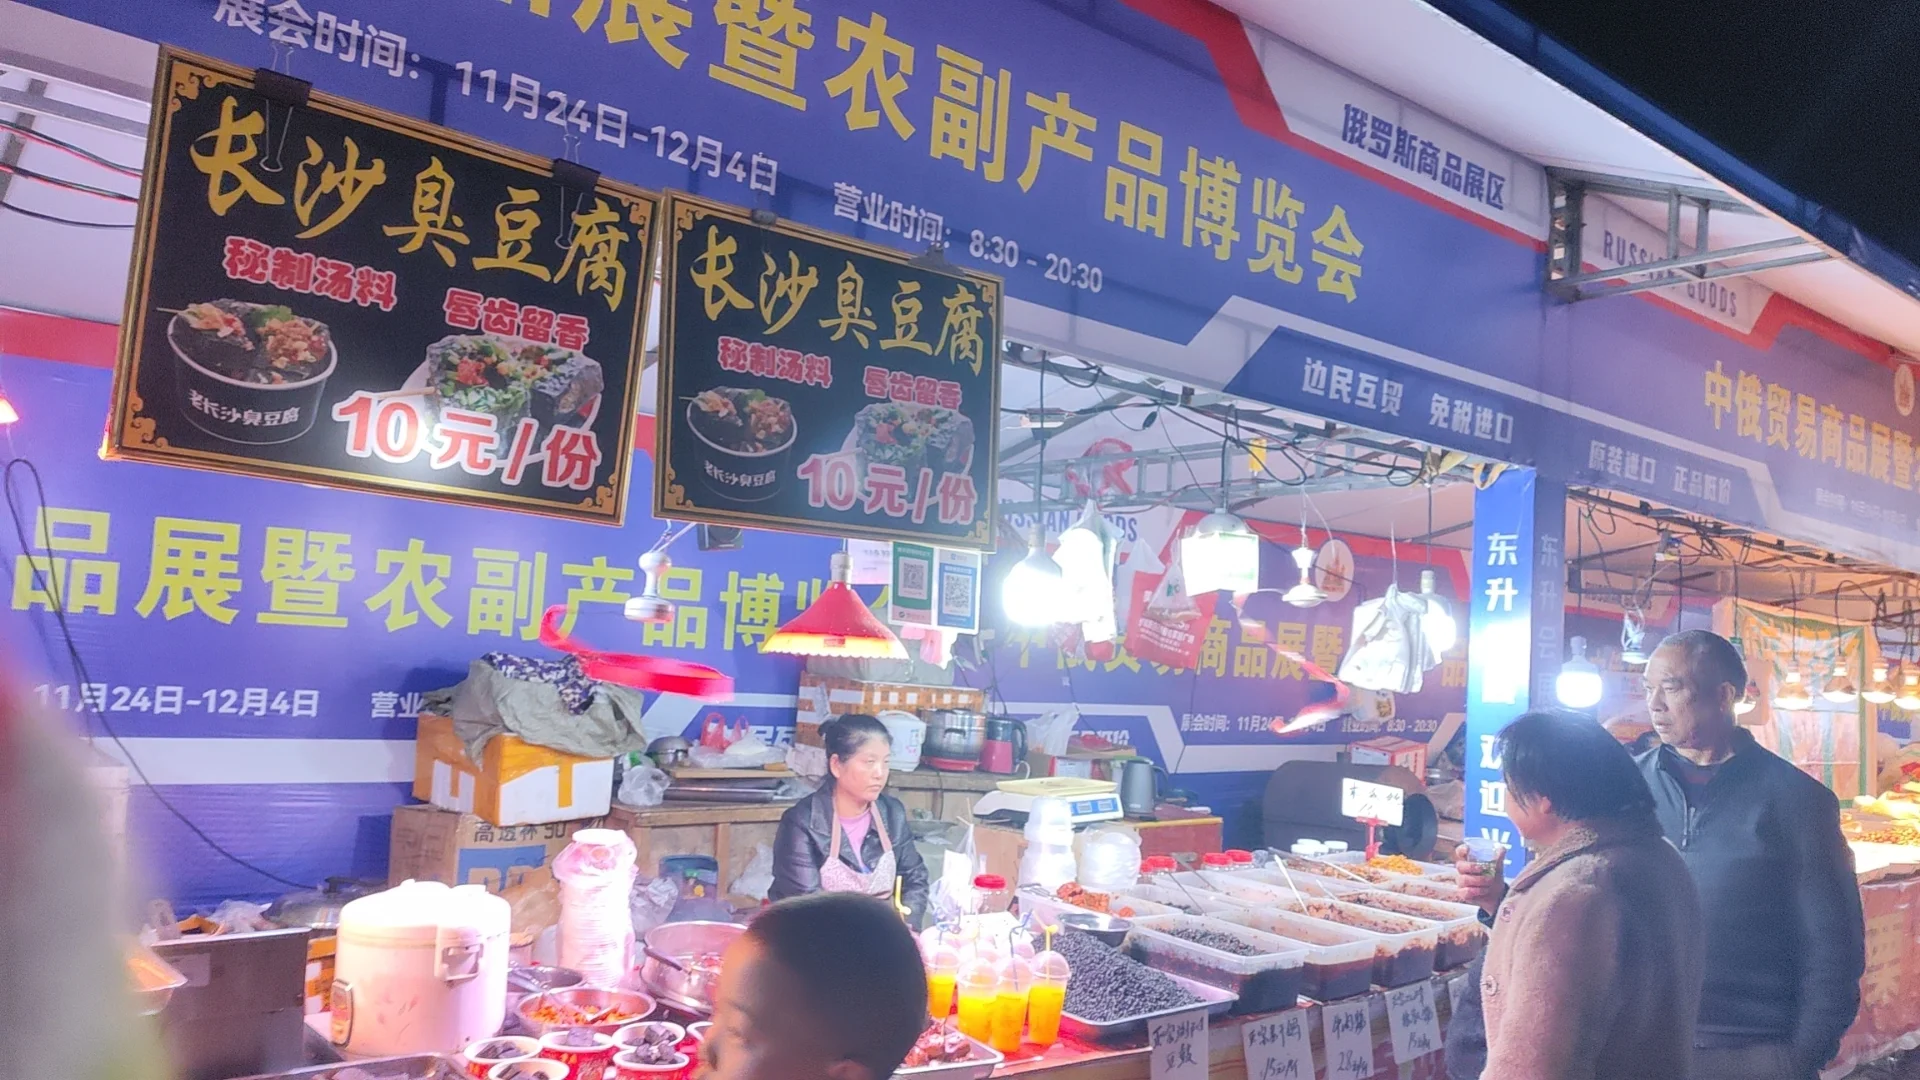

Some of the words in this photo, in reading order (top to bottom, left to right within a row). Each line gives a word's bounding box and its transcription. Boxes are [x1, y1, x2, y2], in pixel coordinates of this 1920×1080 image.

[504, 0, 1364, 303] 展暨农副产品博览会
[1341, 103, 1506, 211] 俄罗斯商品展区
[189, 96, 632, 313] 长沙臭豆腐
[224, 236, 398, 312] 秘制汤料
[690, 226, 984, 377] 长沙臭豆腐
[969, 229, 1019, 268] 8:30
[1044, 253, 1103, 293] 20:30
[443, 289, 590, 352] 唇齿留香
[717, 335, 832, 388] 秘制汤料
[863, 366, 962, 411] 唇齿留香
[1302, 357, 1403, 417] 边民互贸
[1429, 393, 1513, 444] 免税进口
[1705, 360, 1920, 493] 中俄贸易商品展暨
[331, 390, 602, 491] 10元/份
[797, 453, 978, 526] 10元/份
